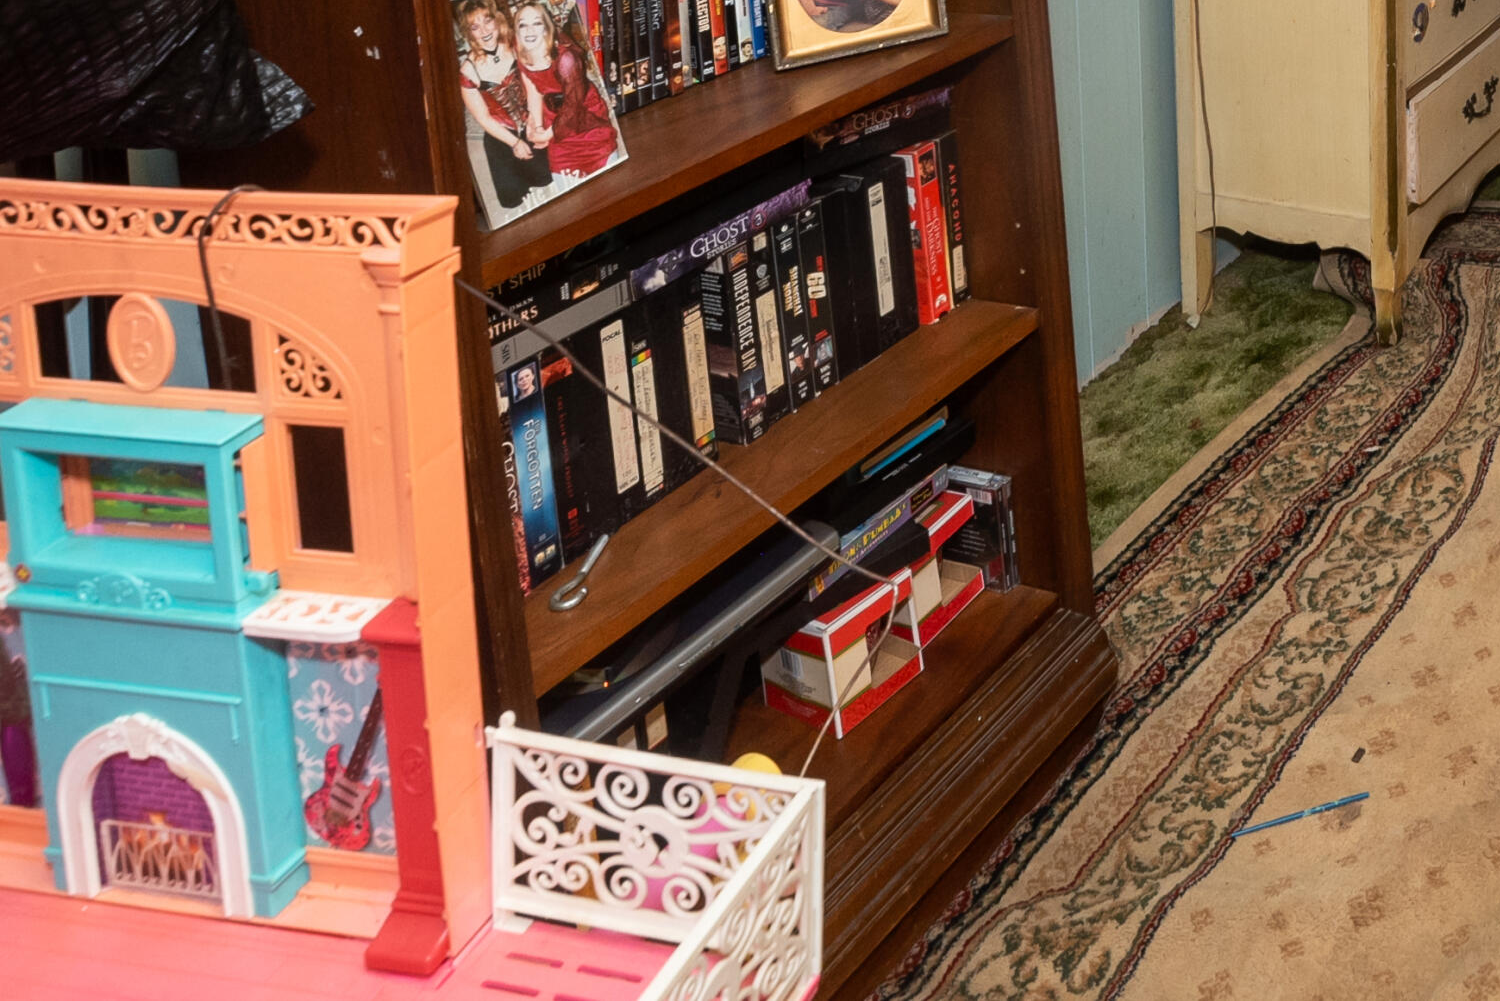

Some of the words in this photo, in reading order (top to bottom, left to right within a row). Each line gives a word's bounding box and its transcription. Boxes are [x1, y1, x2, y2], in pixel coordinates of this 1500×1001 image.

[852, 104, 900, 131] GHOST
[949, 163, 963, 244] ANACOND
[690, 216, 749, 258] GHOST
[755, 213, 763, 227] 3
[707, 238, 738, 260] STORIES
[509, 262, 547, 290] SHIP
[807, 271, 826, 299] 60
[782, 282, 793, 311] NOON
[789, 266, 803, 318] SHANGHAI
[732, 269, 755, 349] INDEPENDENCE
[742, 350, 757, 373] DAY
[522, 419, 545, 512] FORGOTTEN
